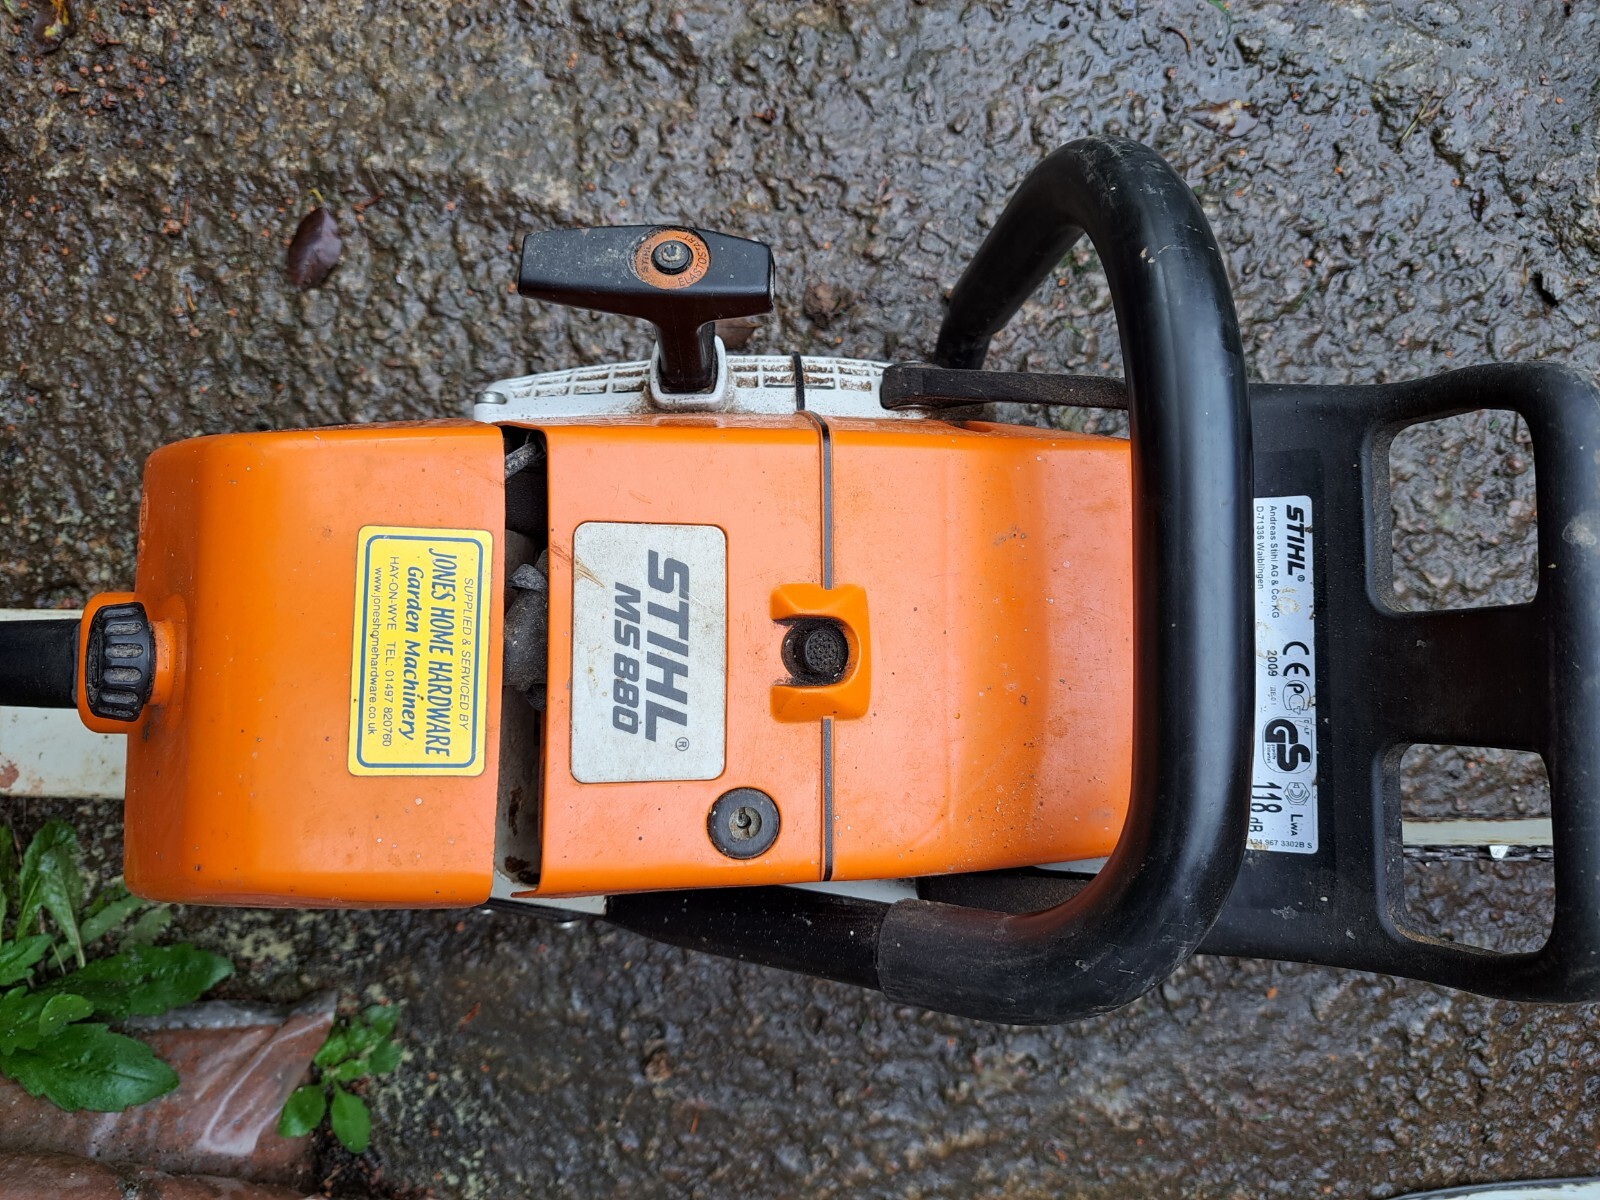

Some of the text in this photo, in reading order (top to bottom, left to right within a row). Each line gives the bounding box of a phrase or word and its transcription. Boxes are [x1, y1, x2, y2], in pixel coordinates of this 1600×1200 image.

[1255, 505, 1265, 590] D-71336 Waiblingen
[1269, 505, 1278, 541] Andreas
[1270, 543, 1279, 562] Stihl
[1286, 504, 1305, 576] STIHL
[1270, 564, 1279, 578] AG
[1271, 588, 1280, 603] Co.
[462, 577, 474, 636] SUPPLIED
[1271, 604, 1280, 619] KG
[367, 567, 382, 735] www.joneshomehardware.co.uk
[382, 556, 400, 747] HAY-ON-WYE TEL: 01497 820760
[398, 566, 424, 741] Garden Machinery
[425, 547, 458, 757] JONES HOME HARDWARE
[612, 581, 641, 735] MS 880
[645, 549, 690, 743] STIHL
[1267, 649, 1278, 677] 2009
[459, 650, 472, 711] SERVICED
[458, 715, 469, 731] BY
[1251, 781, 1283, 813] 118
